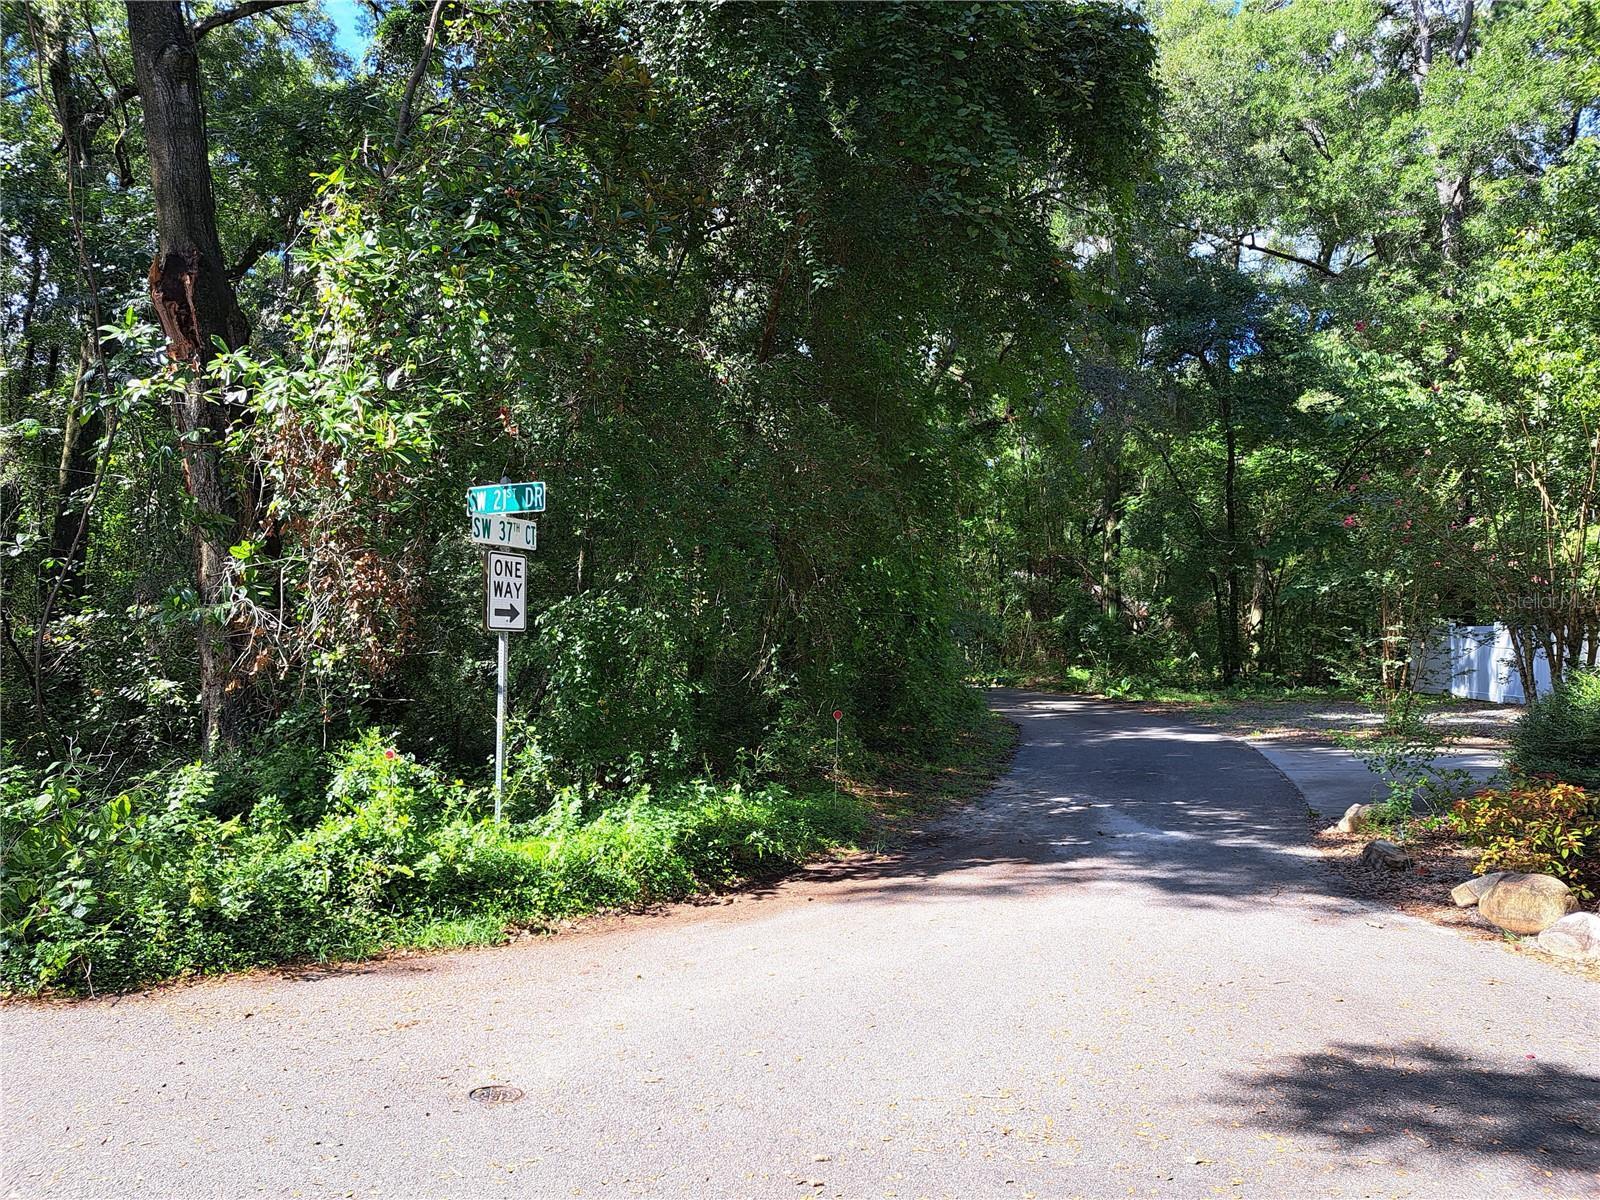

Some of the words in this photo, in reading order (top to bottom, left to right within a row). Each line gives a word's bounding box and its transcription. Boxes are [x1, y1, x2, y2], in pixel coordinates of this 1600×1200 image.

[470, 491, 487, 512] SW
[525, 486, 543, 508] DR
[473, 517, 492, 539] SW
[499, 520, 520, 542] 37TH
[525, 525, 536, 546] CT
[494, 559, 522, 578] ONE
[493, 580, 523, 599] WAY
